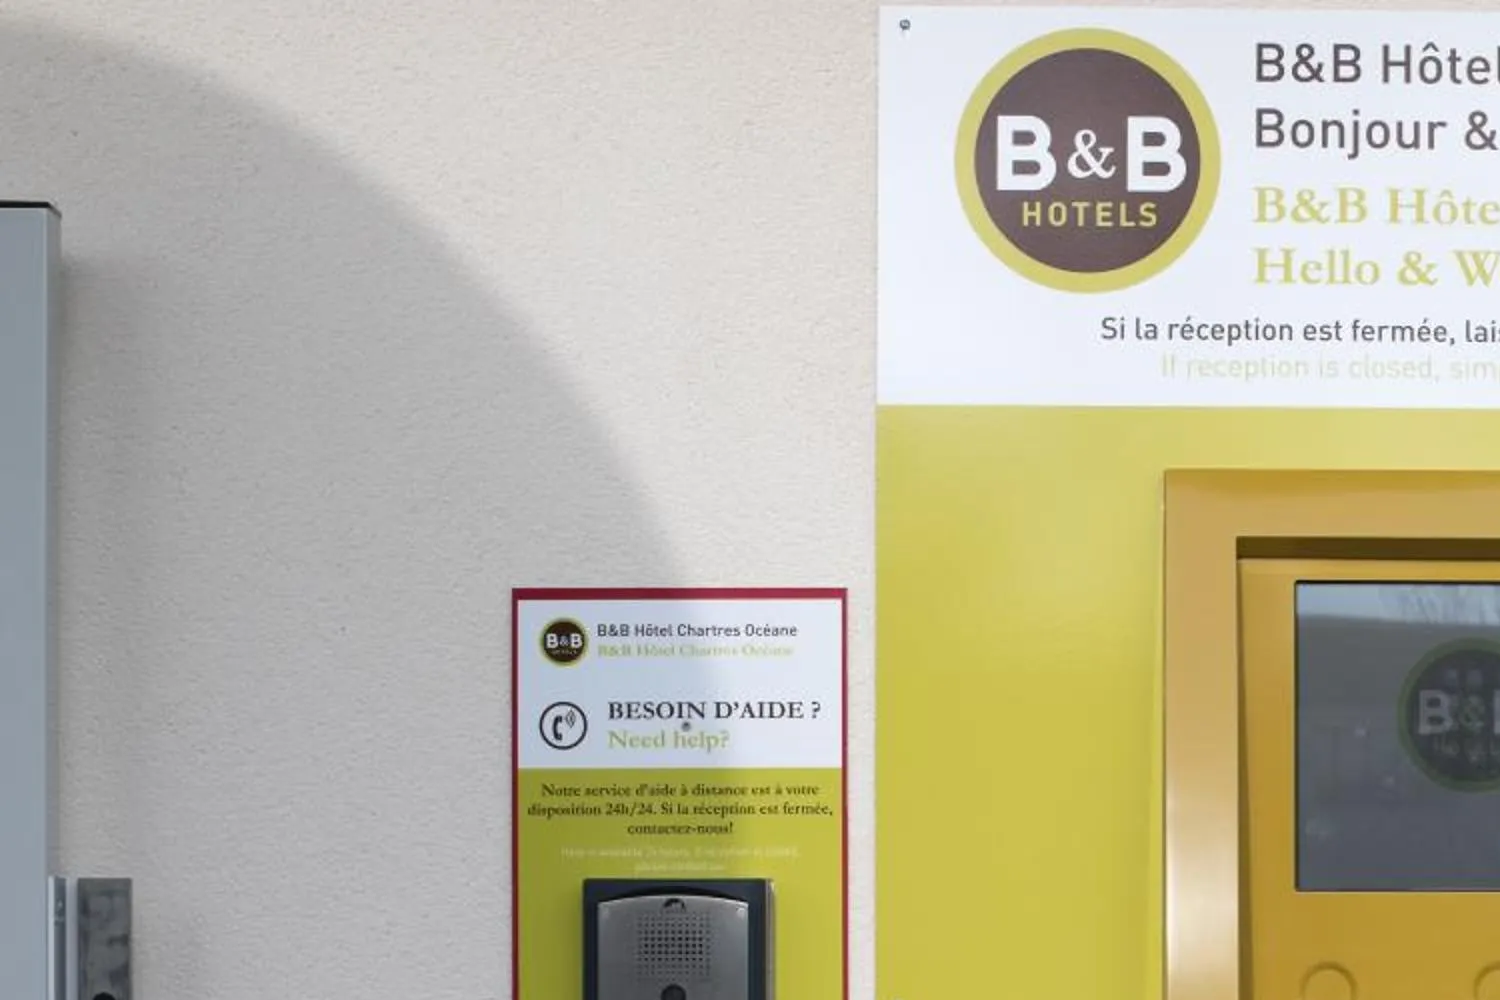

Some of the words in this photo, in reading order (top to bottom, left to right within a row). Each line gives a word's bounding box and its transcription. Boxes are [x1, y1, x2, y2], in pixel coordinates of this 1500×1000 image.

[1255, 43, 1362, 83] B&B
[1255, 108, 1448, 160] Bonjour
[1464, 110, 1498, 151] &
[996, 115, 1188, 192] B&B
[1022, 202, 1158, 227] HOTELS
[1252, 186, 1368, 224] B&B
[1253, 247, 1381, 285] Hello
[1397, 250, 1438, 286] &
[1101, 317, 1126, 340] Si
[1135, 317, 1158, 340] la
[1167, 316, 1293, 346] réception
[1302, 322, 1343, 342] est
[1351, 318, 1456, 345] fermée,
[1186, 354, 1309, 381] reception
[1319, 355, 1339, 377] is
[1349, 355, 1440, 382] closed,
[597, 623, 630, 637] B&B
[634, 622, 673, 637] Hôtel
[677, 623, 741, 637] Chartres
[744, 622, 798, 637] Océane
[608, 701, 706, 720] BESOIN
[715, 701, 804, 720] D'AIDE
[812, 702, 821, 720] ?
[608, 730, 666, 750] Need
[673, 730, 729, 752] help?
[541, 784, 582, 797] Notre
[584, 785, 633, 797] service
[691, 784, 748, 797] distance
[785, 784, 820, 796] votre
[527, 803, 601, 819] disposition
[661, 803, 674, 816] Si
[692, 803, 755, 819] réception
